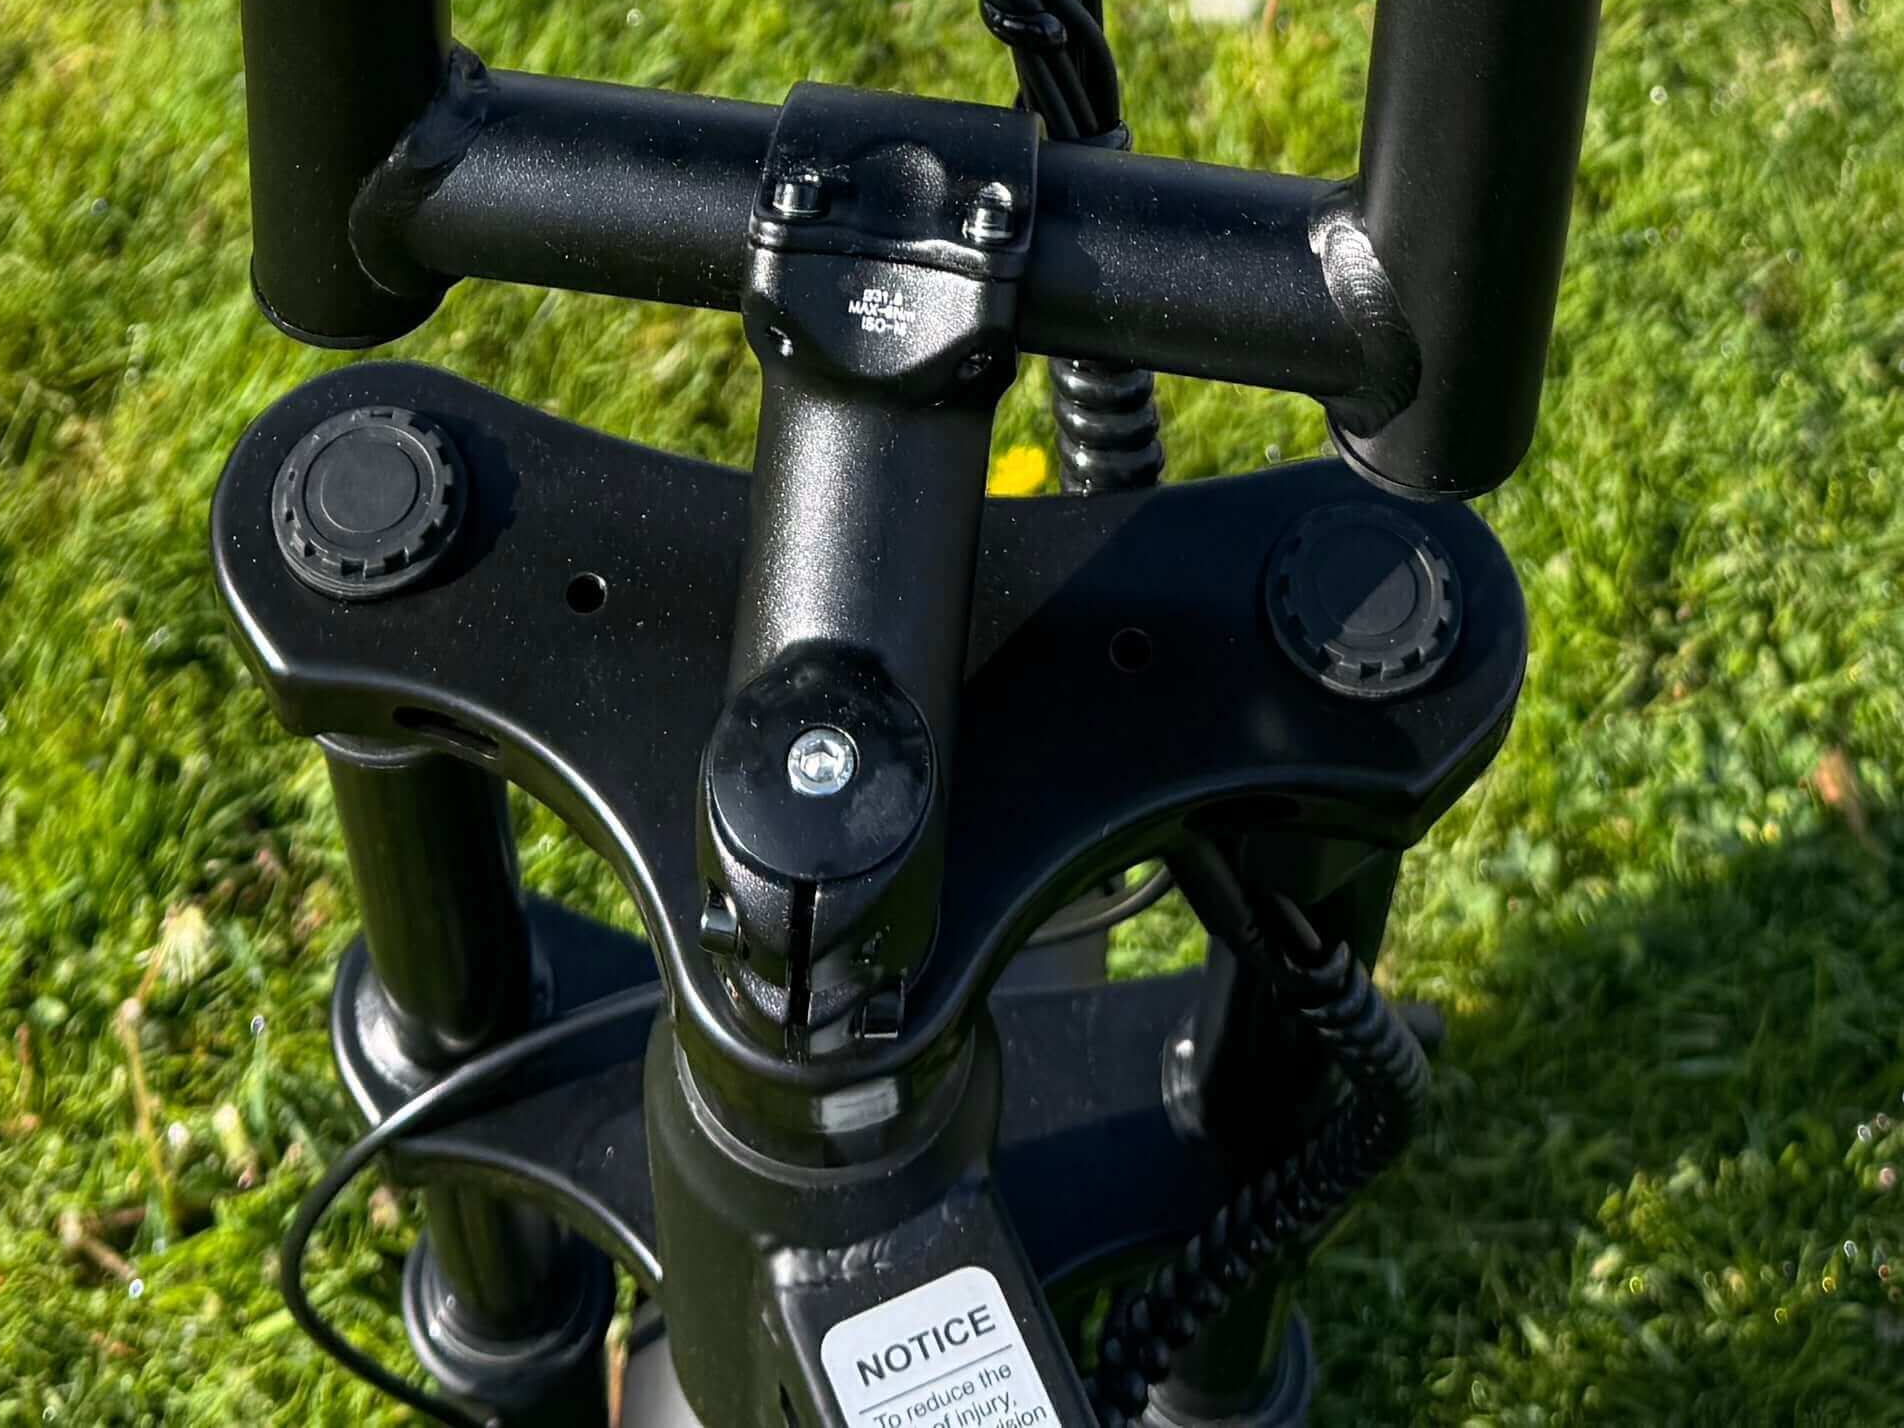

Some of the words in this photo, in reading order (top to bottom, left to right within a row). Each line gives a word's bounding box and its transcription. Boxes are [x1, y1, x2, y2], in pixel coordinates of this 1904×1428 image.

[855, 1303, 997, 1388] NOTICE
[907, 1380, 976, 1422] reduce
[978, 1363, 1012, 1389] the
[957, 1391, 1017, 1428] injury,
